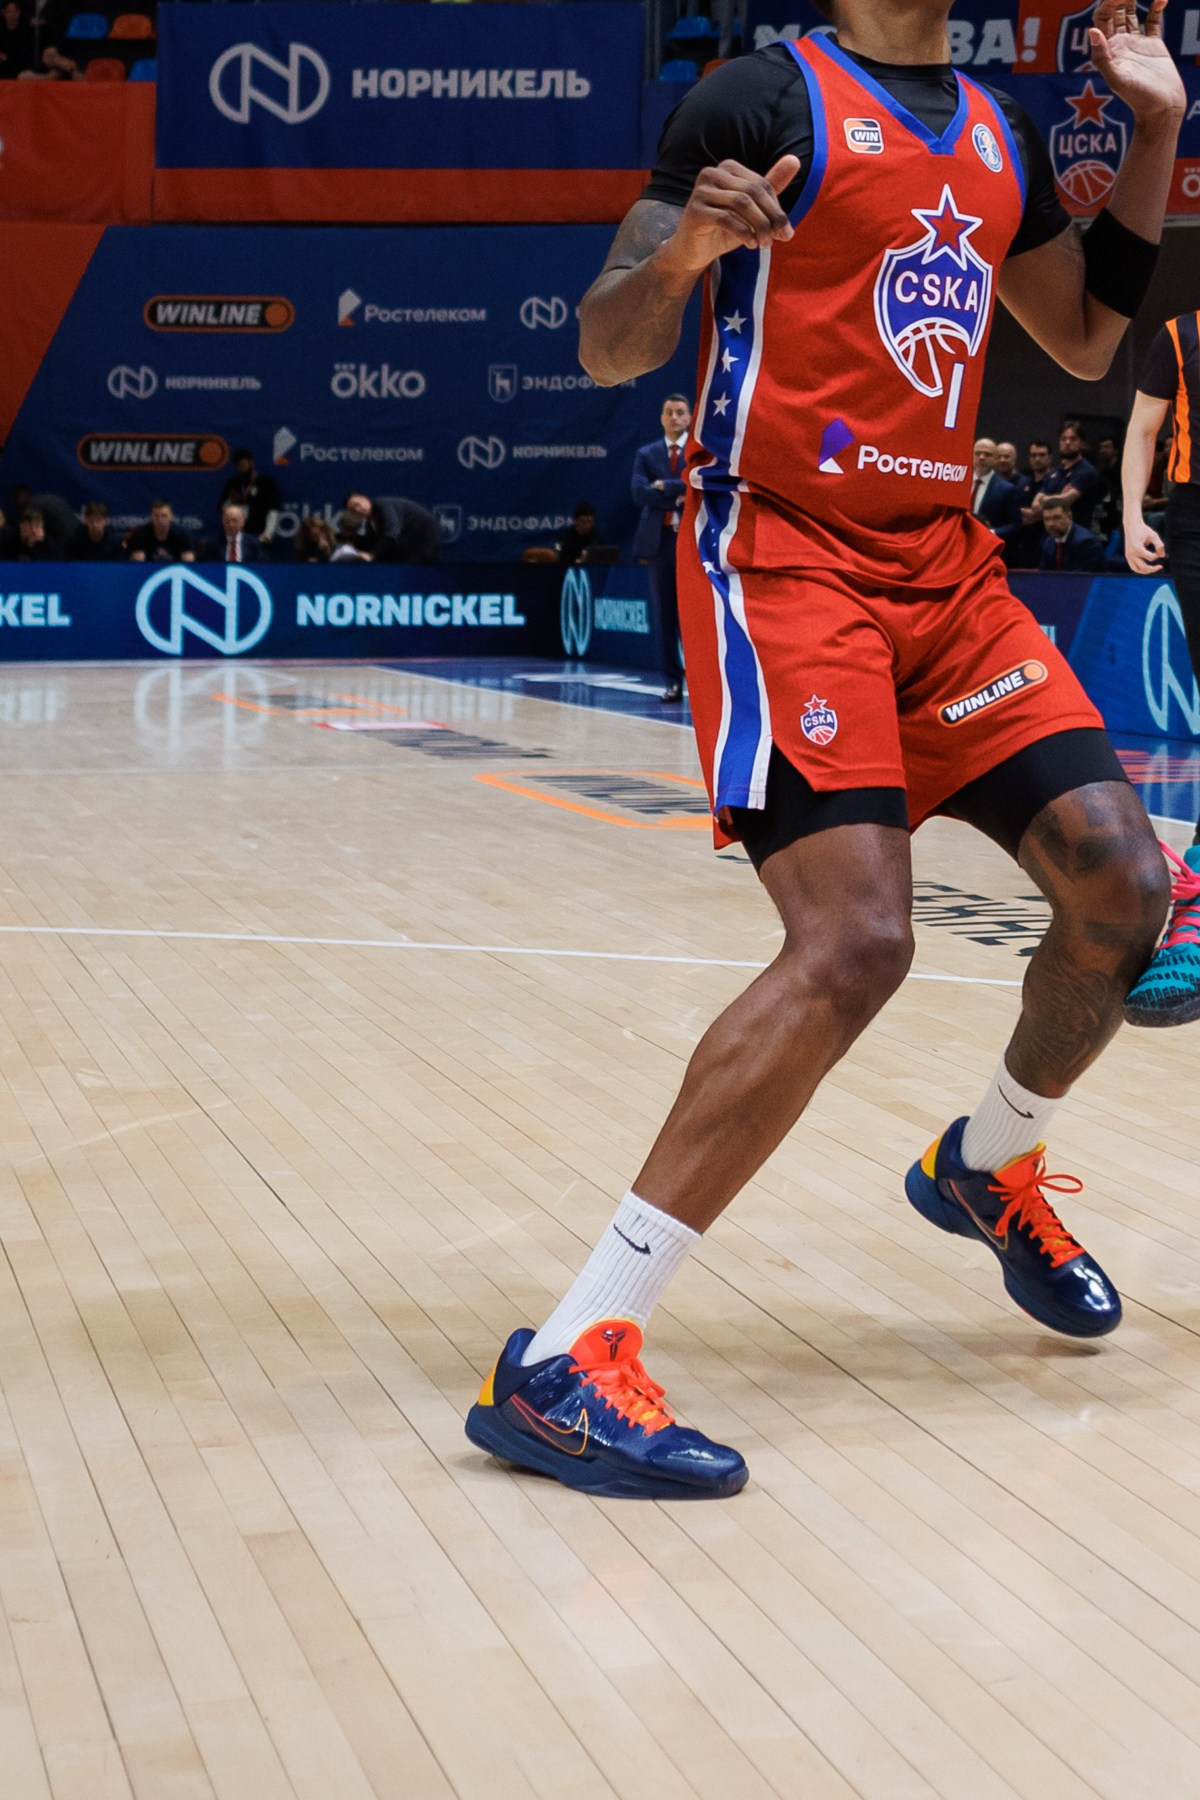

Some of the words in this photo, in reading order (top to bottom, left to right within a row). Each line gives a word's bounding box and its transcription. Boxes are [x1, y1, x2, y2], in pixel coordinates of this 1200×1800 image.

[352, 69, 591, 99] НОРНИКЕЛЬ
[853, 130, 880, 143] WIN
[1059, 133, 1118, 161] ЦСКА
[895, 270, 979, 314] CSKA
[156, 302, 262, 325] WINLINE
[364, 304, 486, 323] Ростелеком
[165, 376, 262, 391] НОРНИКЕЛЬ
[90, 440, 195, 463] WINLINE
[300, 443, 424, 462] Ростелеком
[513, 445, 607, 459] НОРНИКЕЛЬ
[296, 594, 525, 625] NORNICKEL
[945, 670, 1025, 722] WINLINE
[804, 713, 834, 728] CSKA
